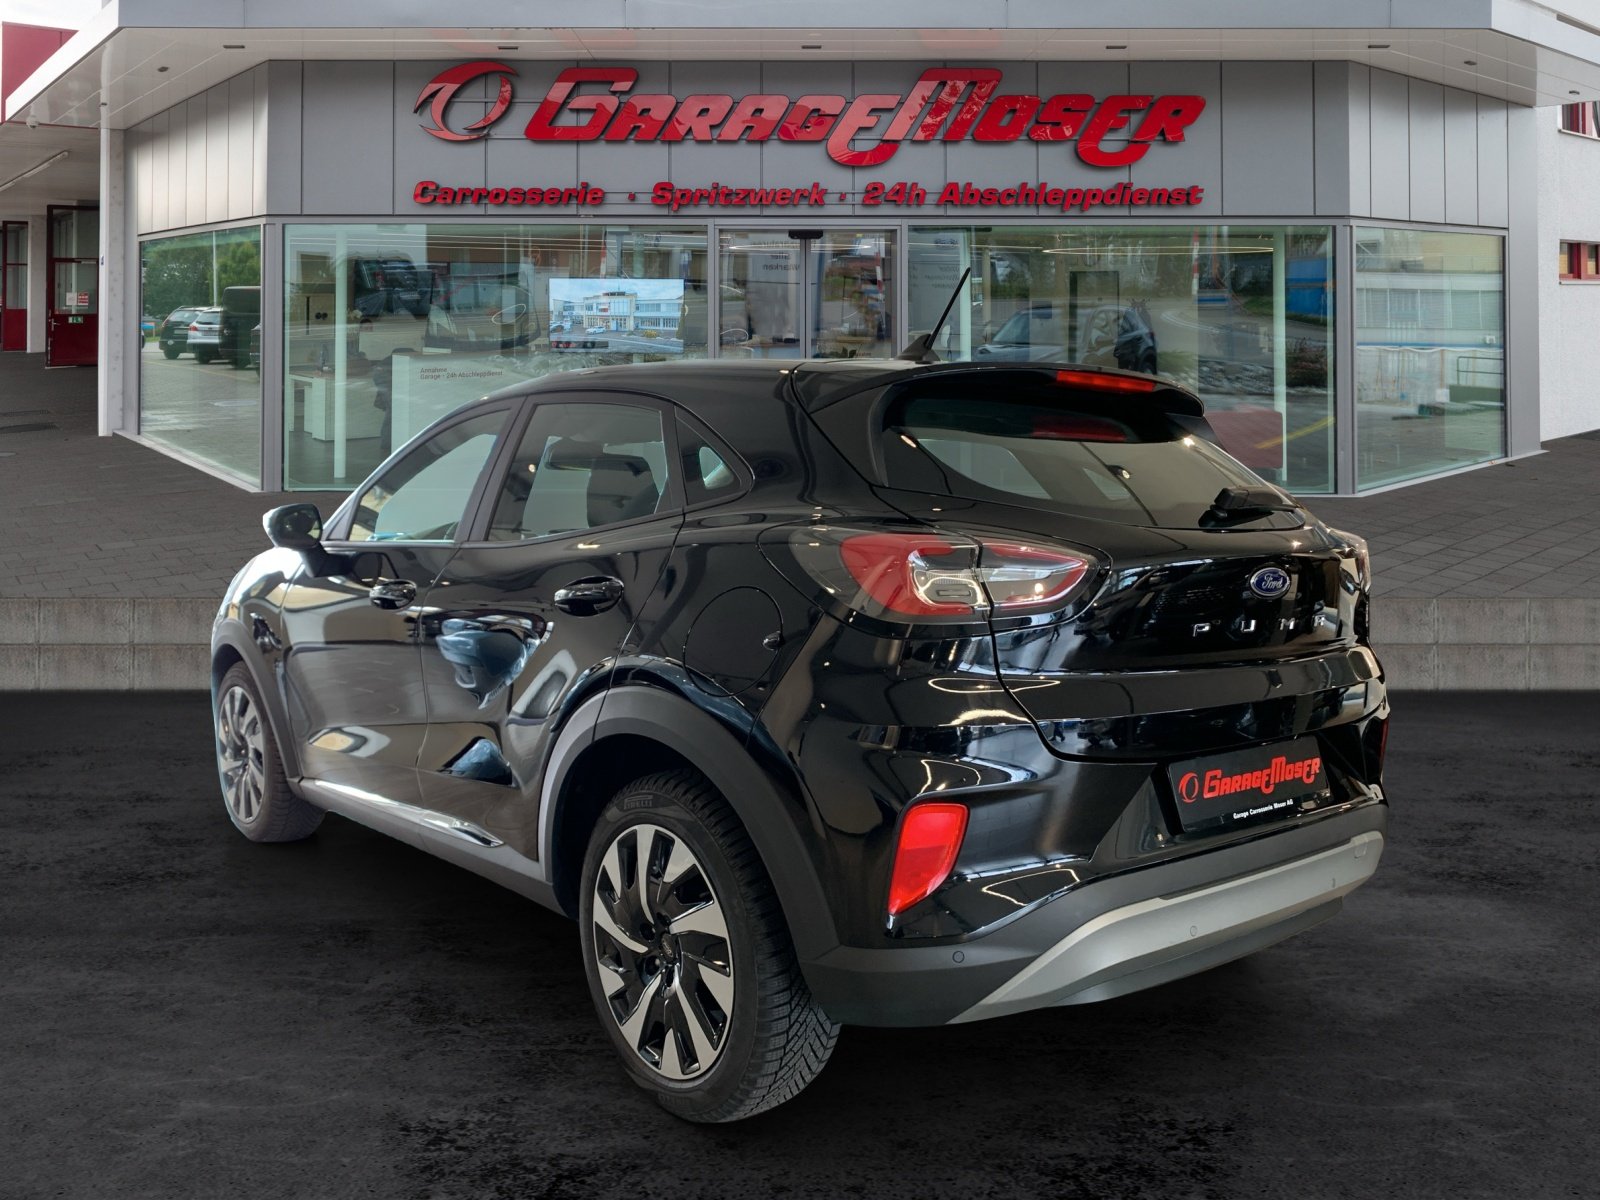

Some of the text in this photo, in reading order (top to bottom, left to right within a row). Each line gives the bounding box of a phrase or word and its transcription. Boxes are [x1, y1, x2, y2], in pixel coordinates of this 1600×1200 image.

[413, 181, 605, 205] Carrosserie
[651, 182, 827, 211] Spritzwerk
[863, 182, 927, 206] 24h
[937, 182, 1204, 212] Abschleppdienst
[1261, 573, 1284, 590] Ford
[1192, 615, 1326, 637] PUMA
